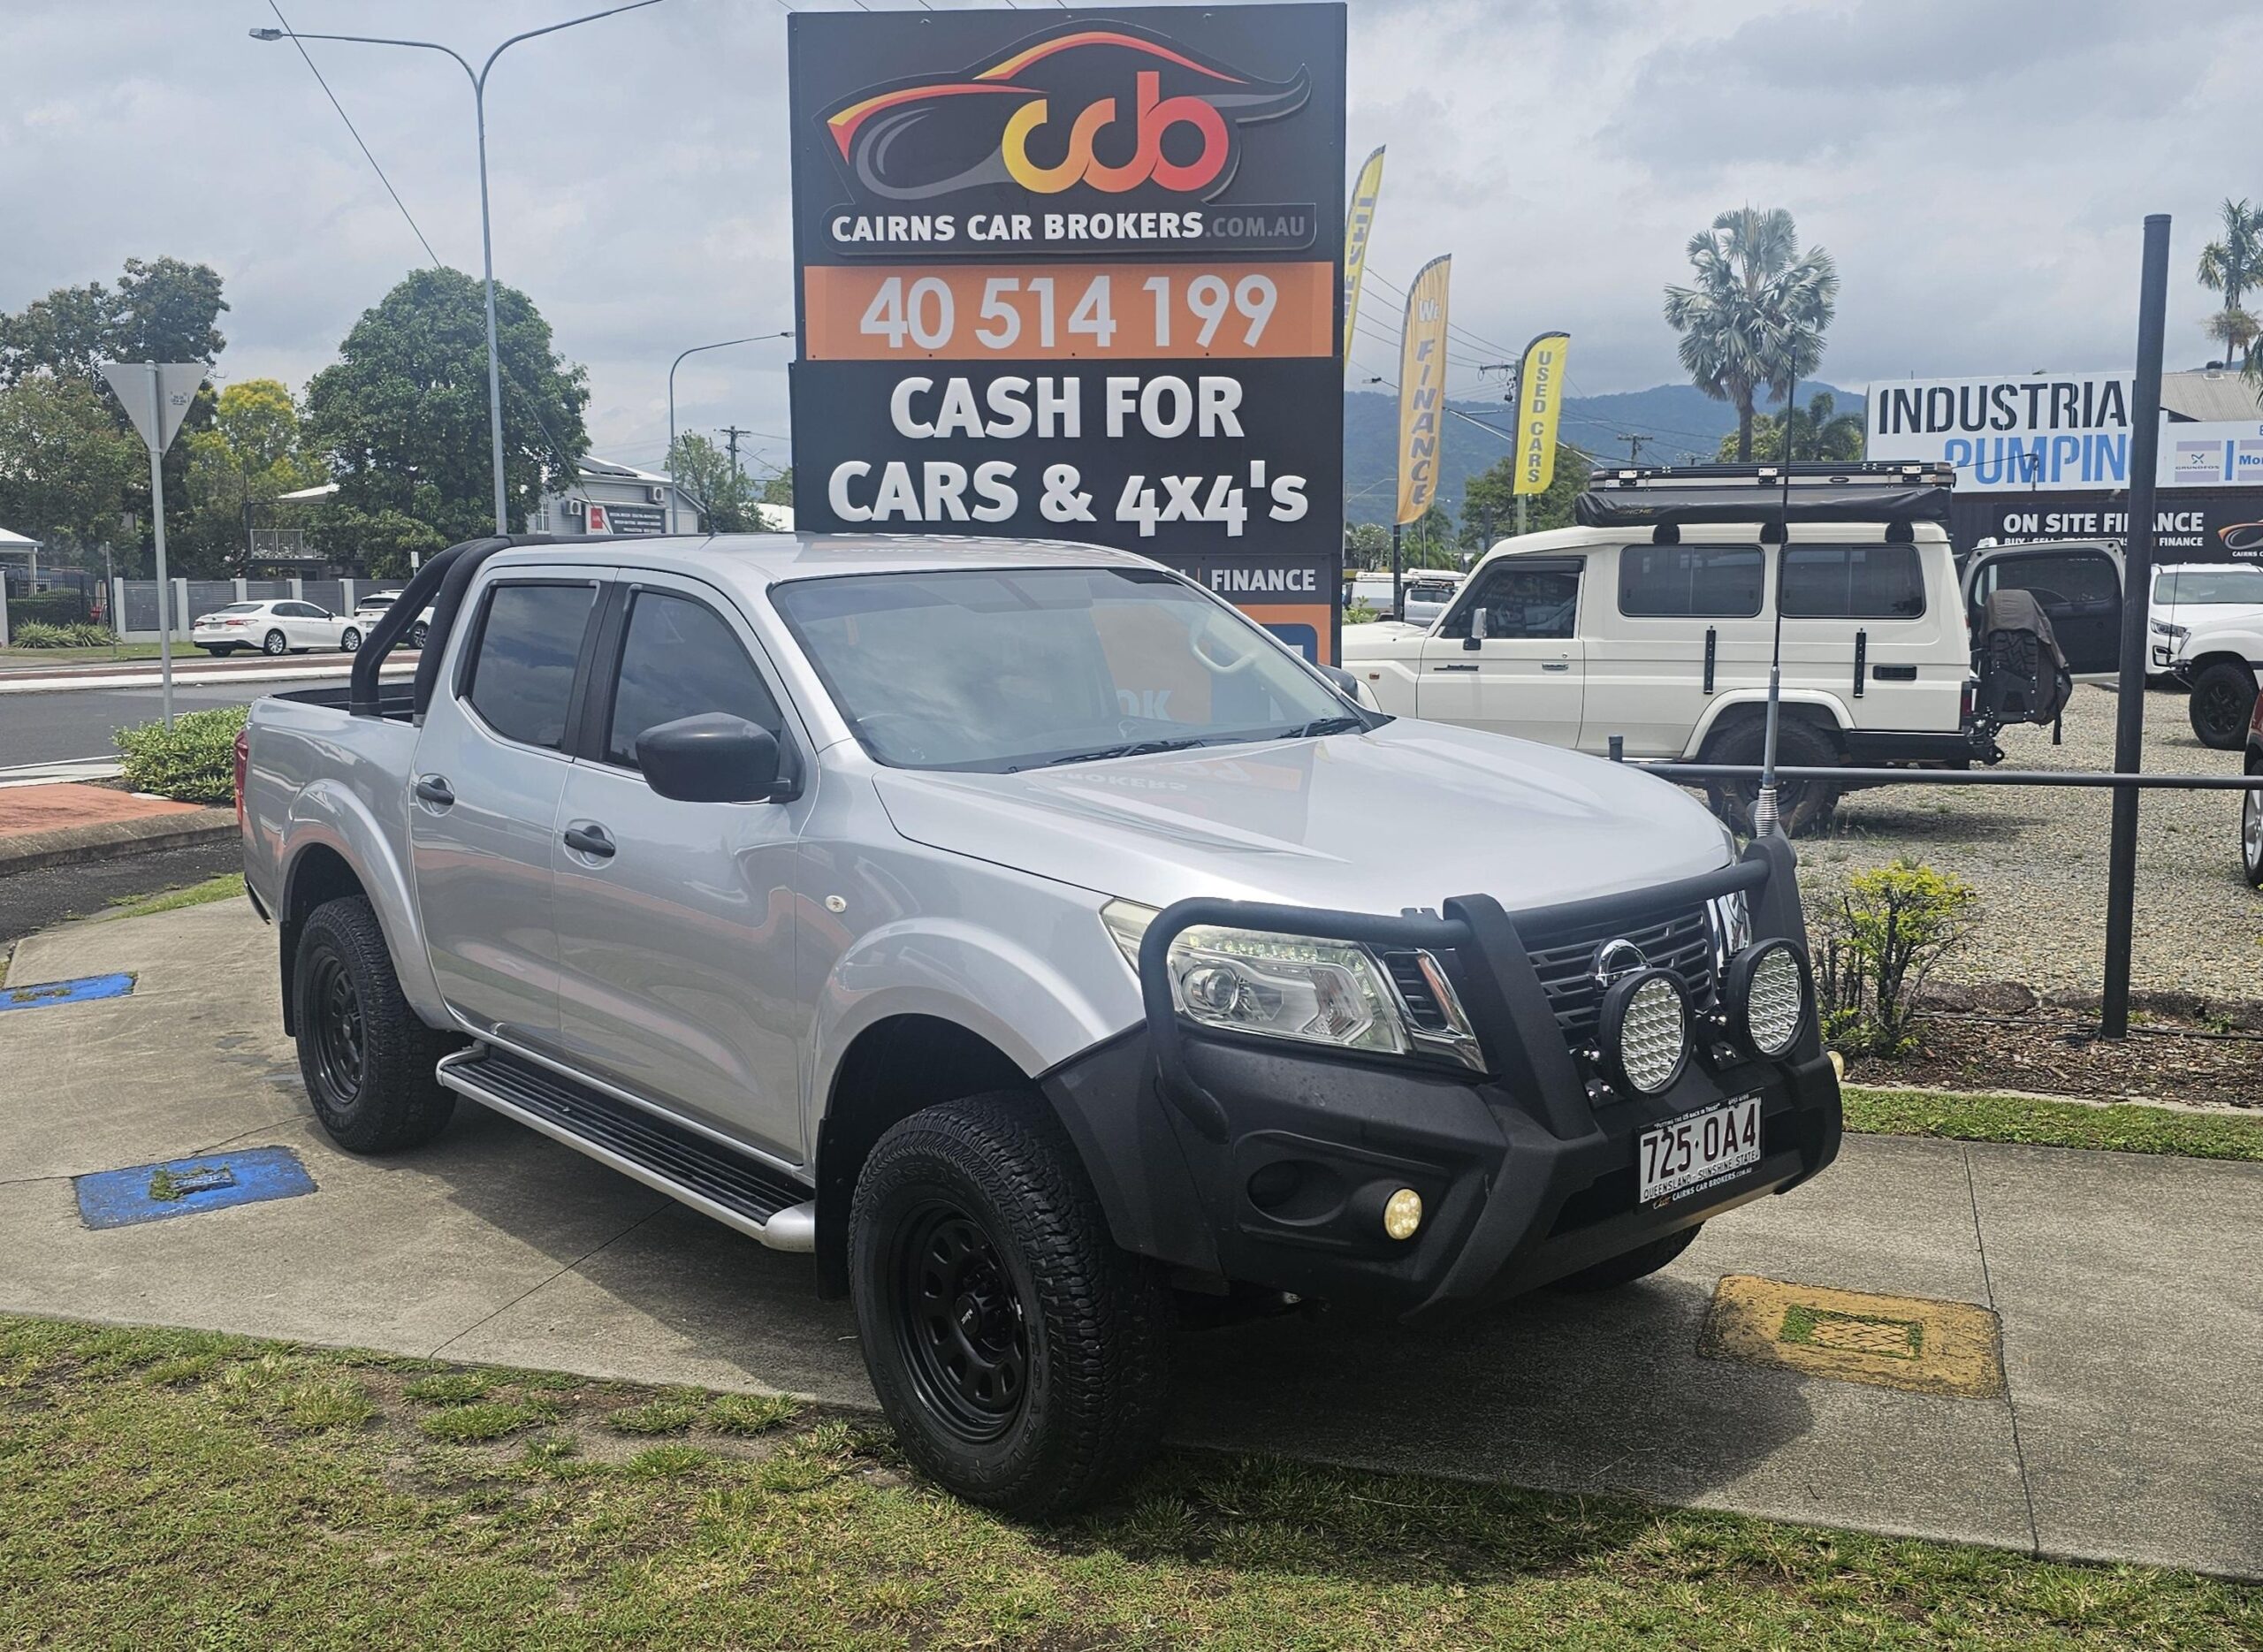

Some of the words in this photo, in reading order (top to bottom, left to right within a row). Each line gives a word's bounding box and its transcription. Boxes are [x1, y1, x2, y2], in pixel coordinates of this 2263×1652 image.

[831, 215, 955, 242] CAIRNS
[967, 214, 1032, 240] CAR
[860, 277, 955, 350] 40
[975, 275, 1116, 349] 514
[1143, 274, 1278, 348] 199
[889, 376, 1082, 440] CASH
[1106, 375, 1246, 439] FOR
[1532, 350, 1552, 414] USED
[1878, 379, 2137, 435] INDUSTRIA
[1411, 339, 1436, 506] FINANCE
[1528, 422, 1544, 483] CARS
[827, 461, 1019, 523] CARS
[1040, 464, 1097, 523] &
[2003, 514, 2038, 533] ON
[2045, 514, 2097, 533] SITE
[2103, 513, 2204, 532] FINCE
[2159, 537, 2204, 546] FINANCE
[1211, 569, 1316, 591] FINANCE
[1643, 1173, 1693, 1199] QUEENSLAND
[1697, 1159, 1733, 1180] SUNSHINE
[1672, 1186, 1695, 1201] CAIRNS
[1695, 1181, 1709, 1192] CAR
